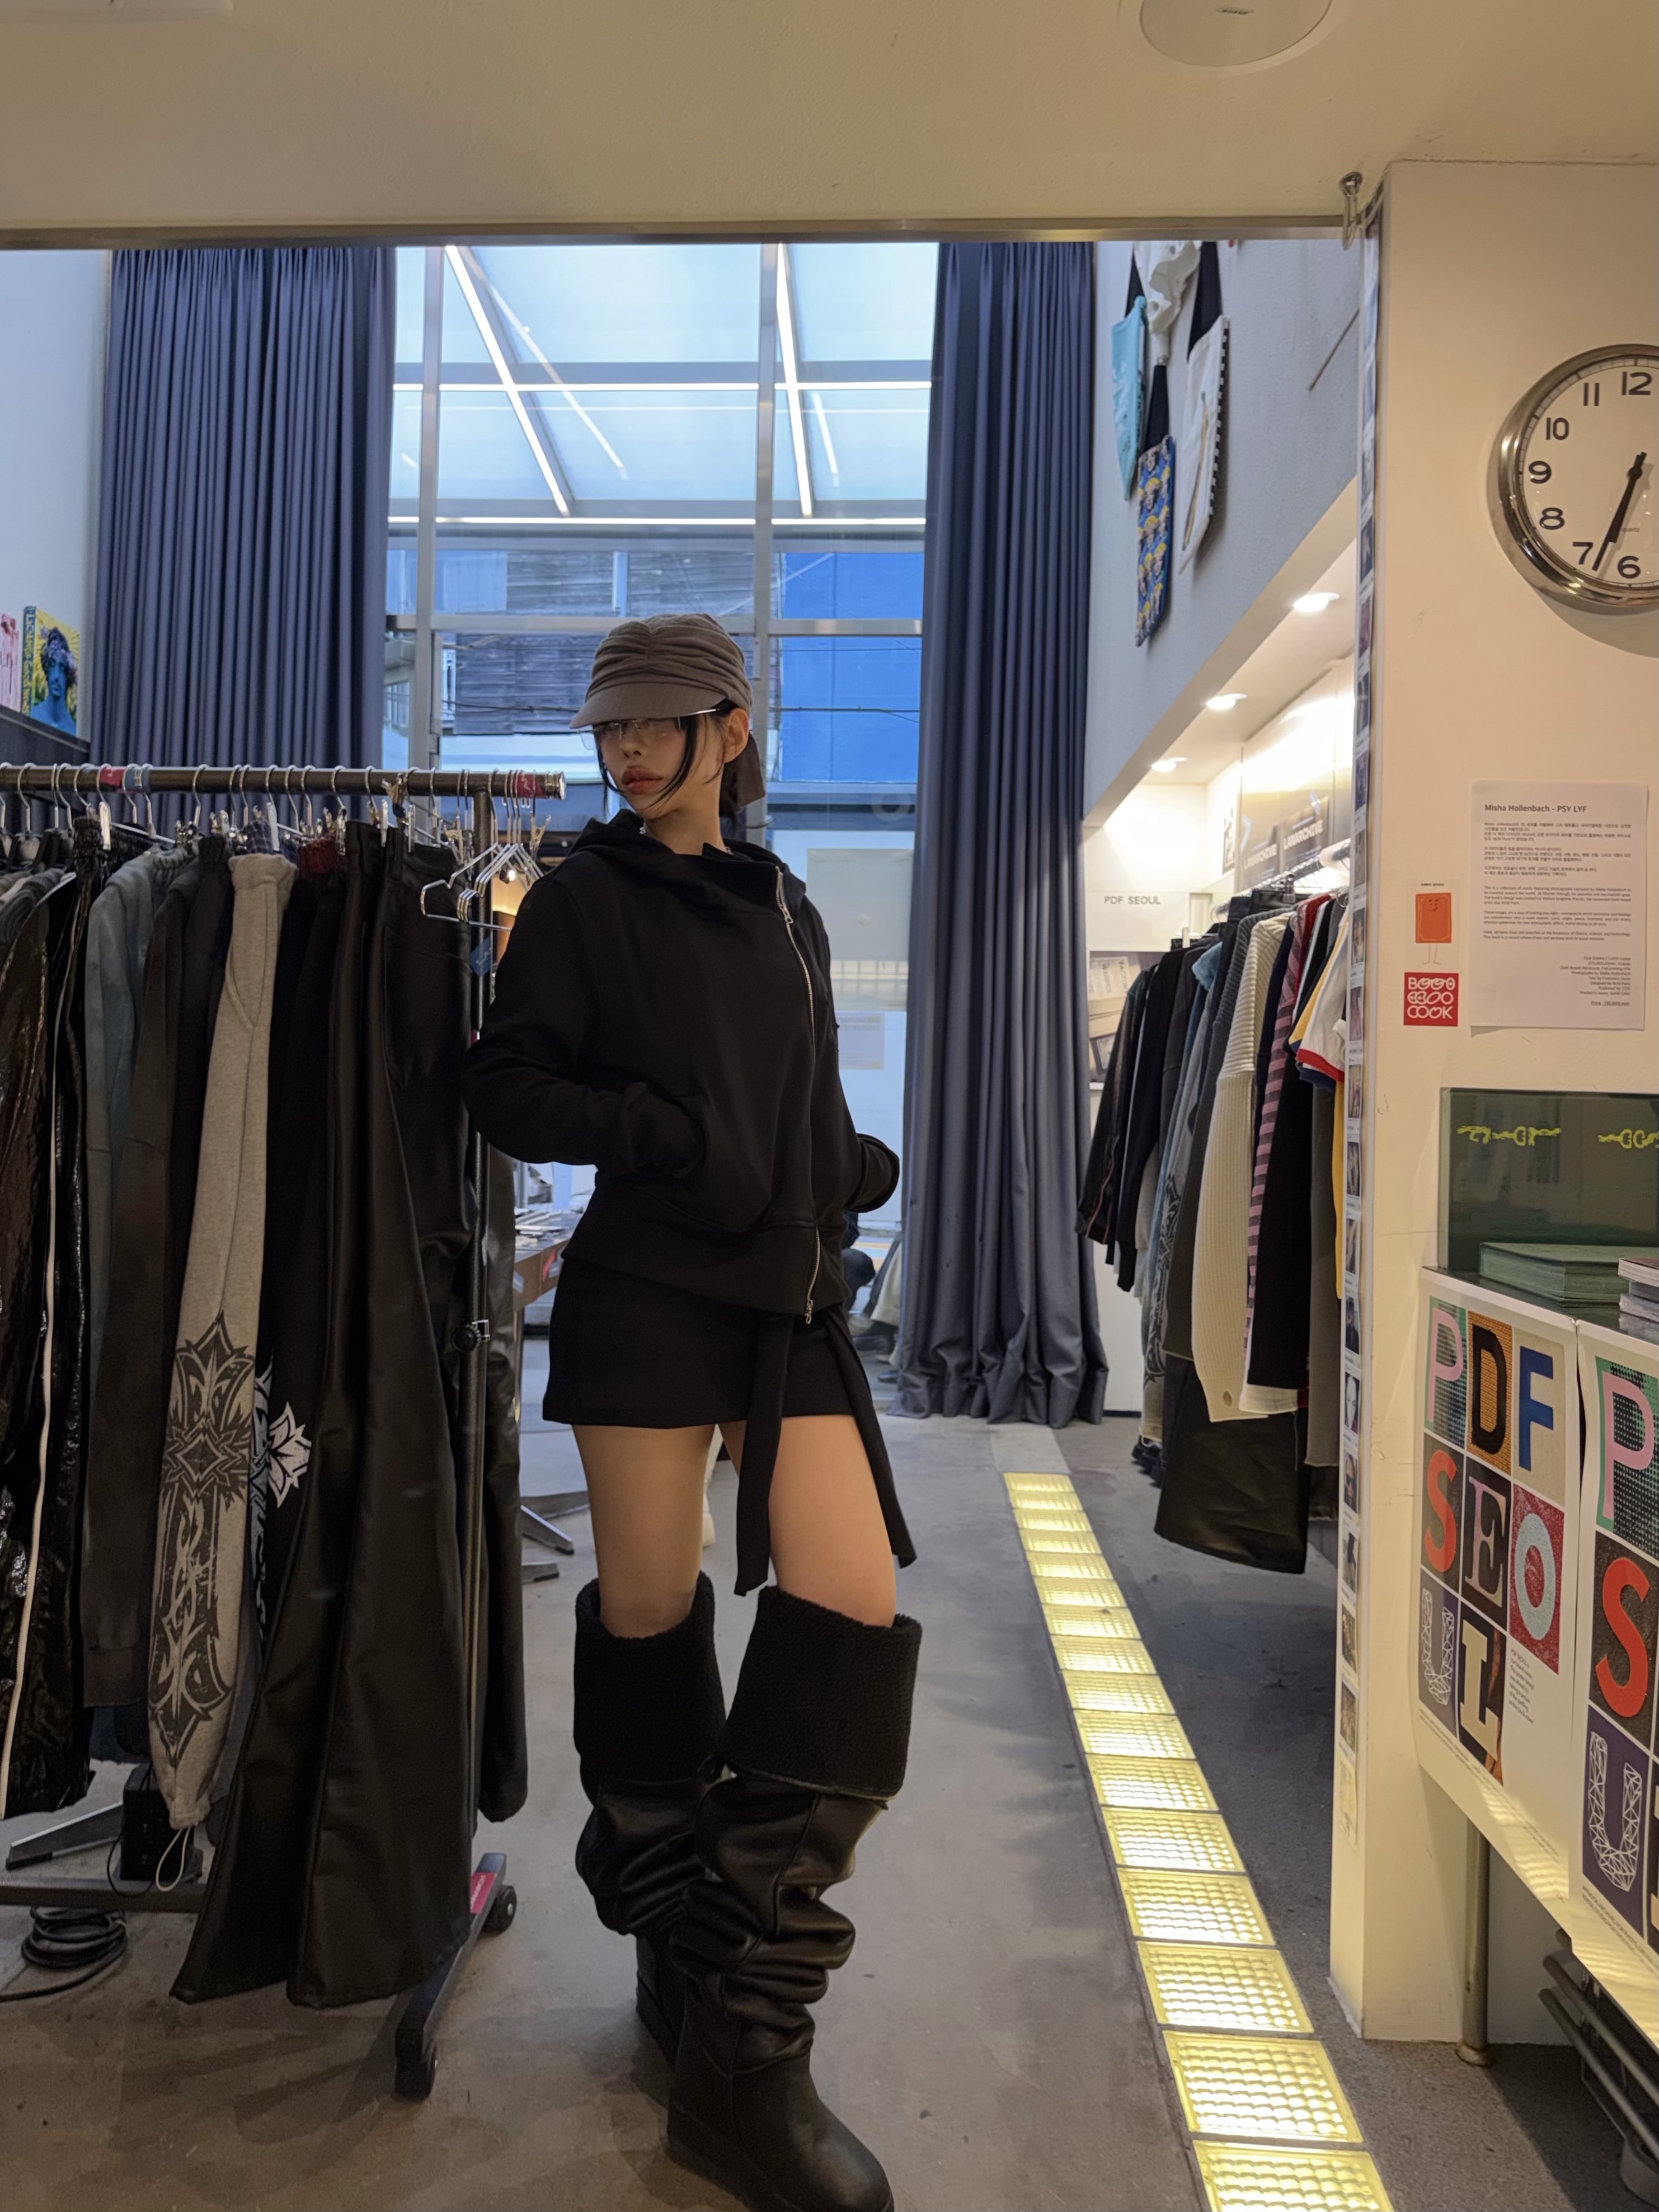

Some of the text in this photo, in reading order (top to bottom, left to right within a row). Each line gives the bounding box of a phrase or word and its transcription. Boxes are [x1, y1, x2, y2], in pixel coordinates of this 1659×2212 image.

[1583, 382, 1600, 407] 11
[1622, 371, 1652, 396] 12
[1546, 417, 1570, 441] 10
[1528, 460, 1552, 484] 9
[1539, 507, 1566, 530] 8
[1572, 542, 1594, 565] 7
[1618, 555, 1641, 579] 6
[1484, 804, 1506, 813] Misha
[1508, 804, 1549, 813] Hollenbach
[1557, 805, 1572, 814] PSY
[1104, 896, 1162, 905] PDF SEOUL
[1427, 1307, 1554, 1472] PDF
[1423, 1449, 1556, 1641] SEO
[1421, 1588, 1499, 1761] UL
